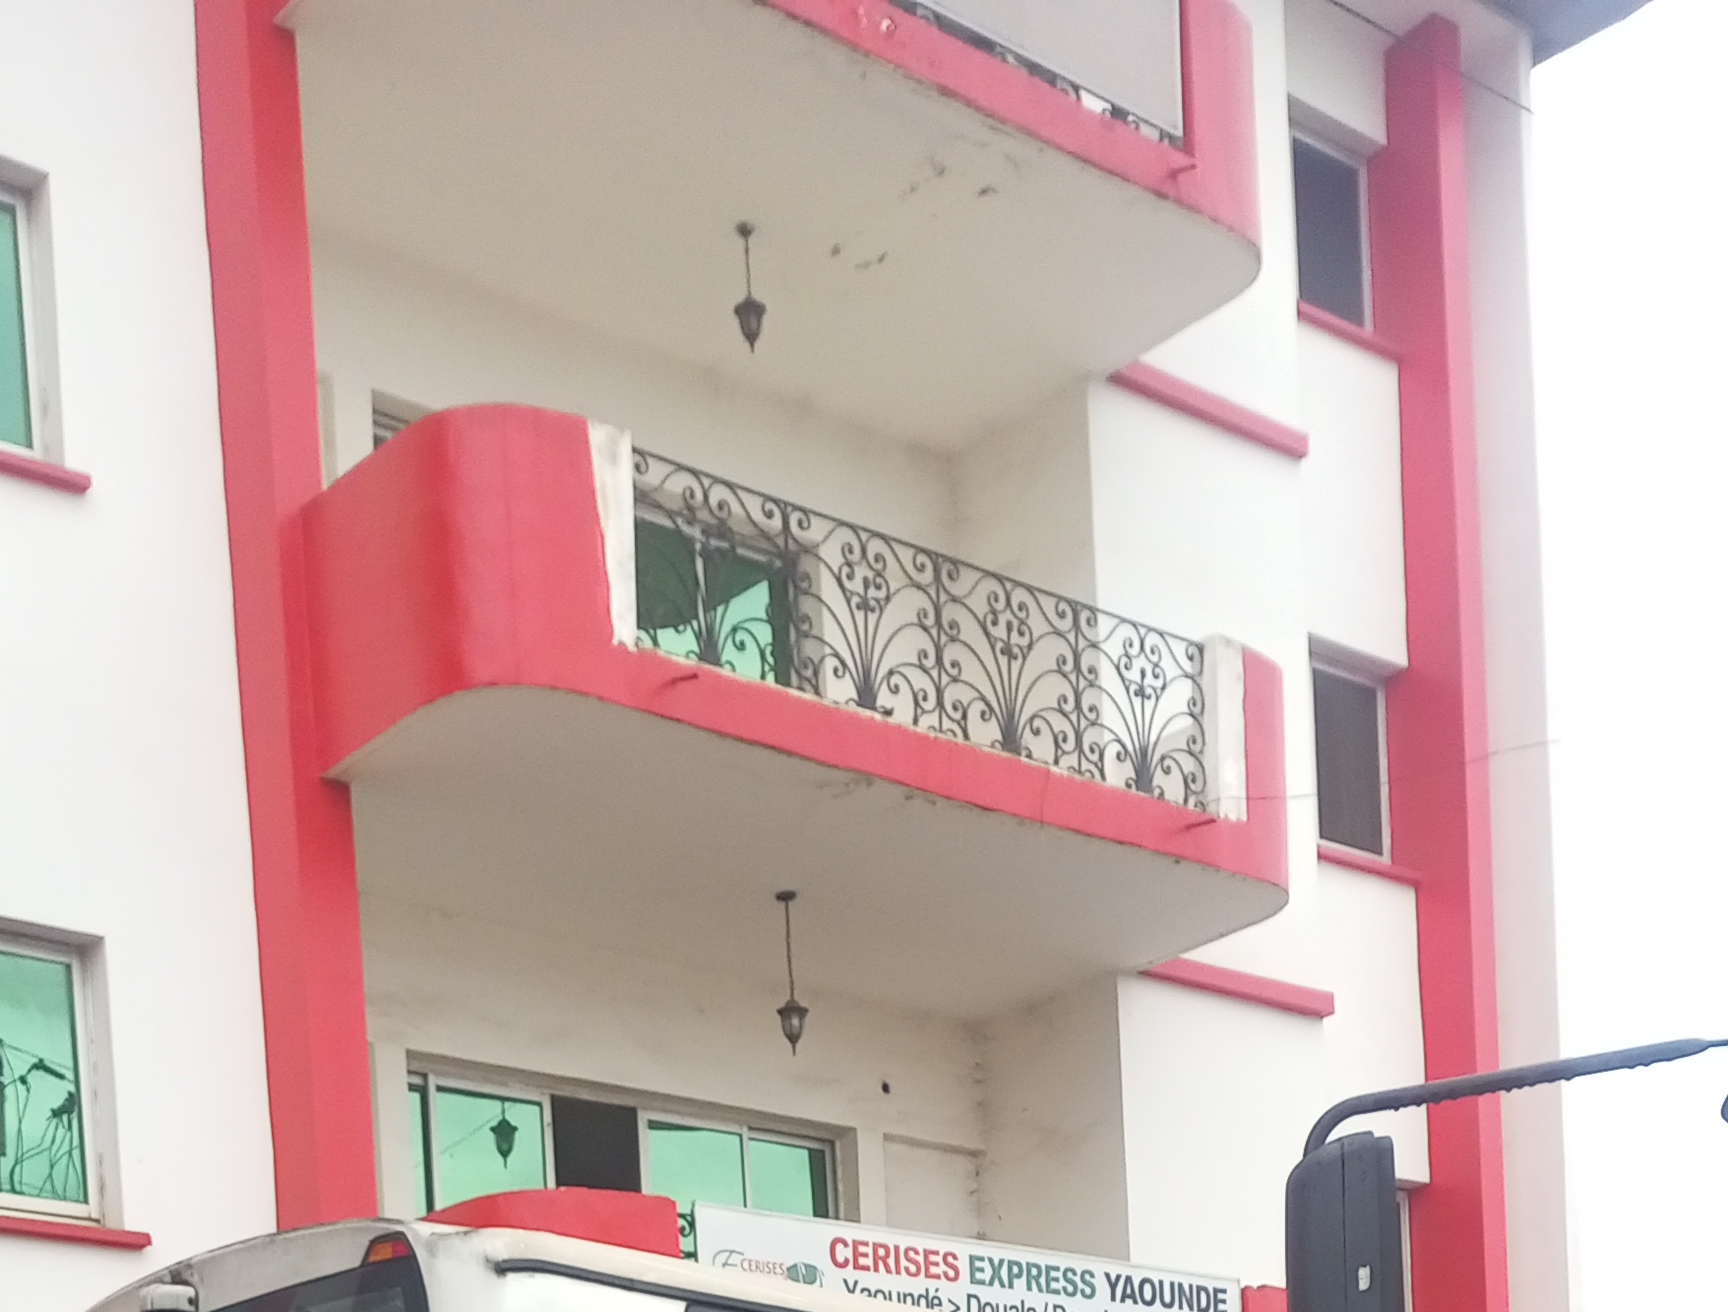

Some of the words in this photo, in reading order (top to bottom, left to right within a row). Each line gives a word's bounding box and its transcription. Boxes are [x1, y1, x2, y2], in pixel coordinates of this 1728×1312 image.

[740, 1258, 785, 1276] CERISES
[829, 1236, 960, 1282] CERISES
[968, 1254, 1096, 1299] EXPRESS
